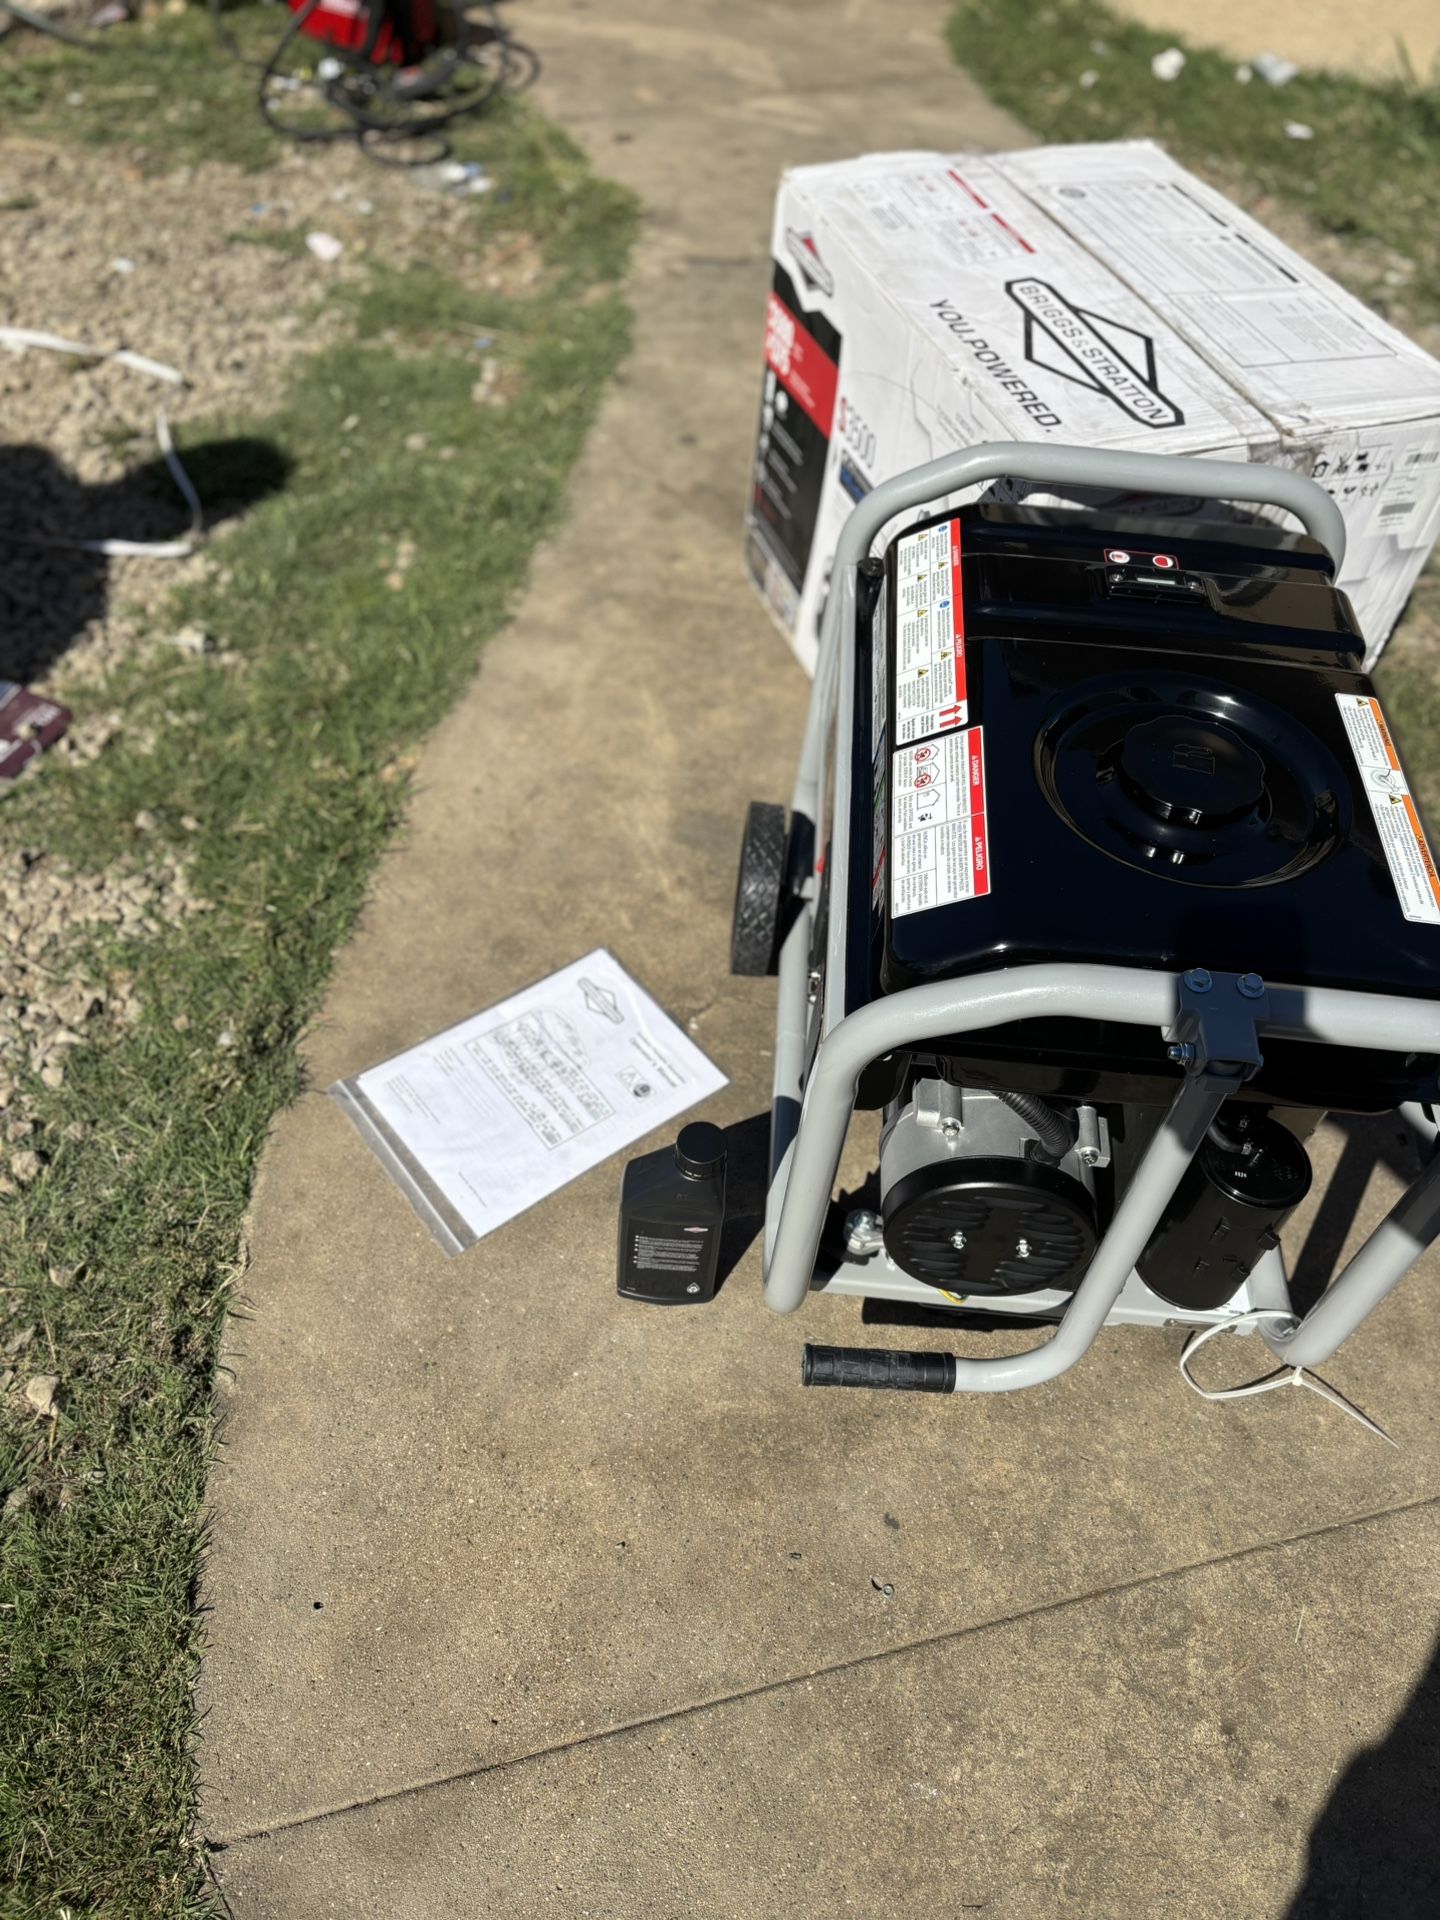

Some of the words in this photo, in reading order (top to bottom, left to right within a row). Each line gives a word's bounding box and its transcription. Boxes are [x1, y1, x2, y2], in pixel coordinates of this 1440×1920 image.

[972, 760, 980, 786] DANGER
[975, 841, 984, 871] PELIGRO
[1418, 838, 1435, 878] ADVERTENCIA
